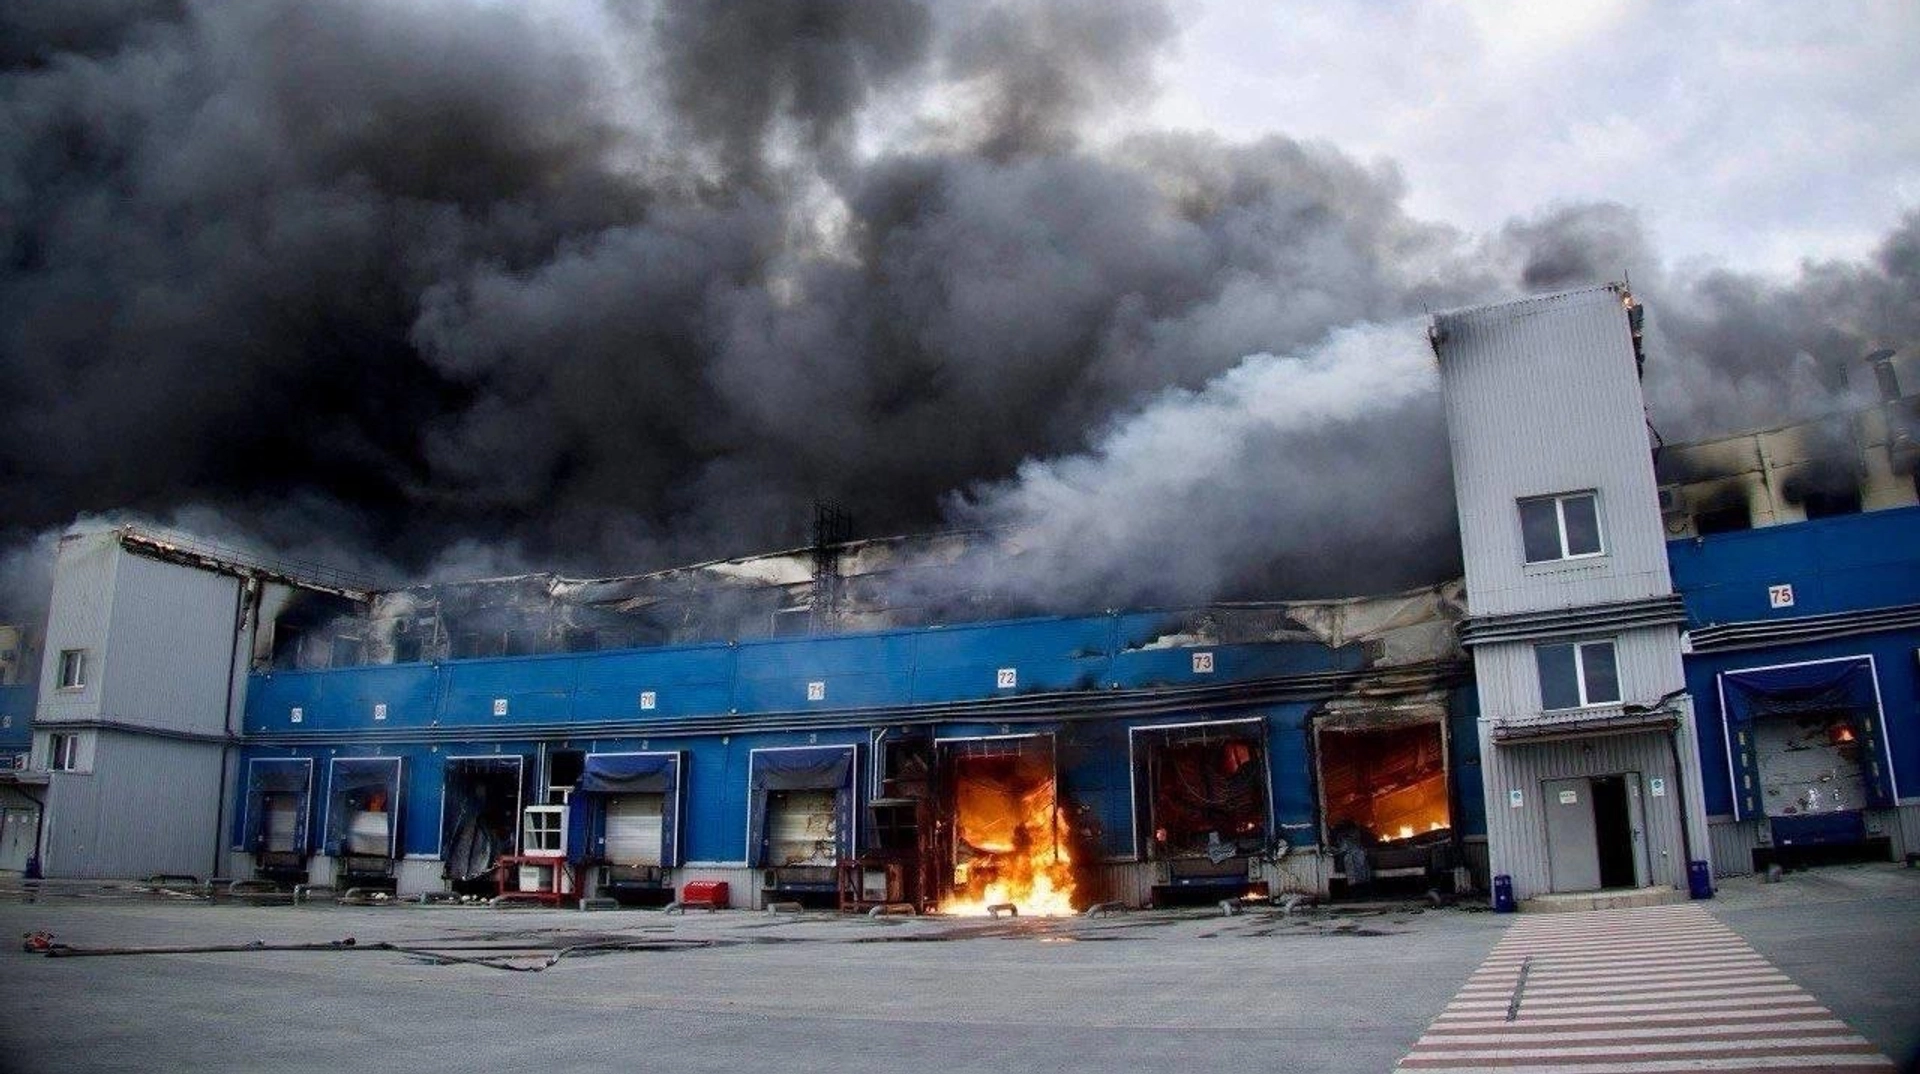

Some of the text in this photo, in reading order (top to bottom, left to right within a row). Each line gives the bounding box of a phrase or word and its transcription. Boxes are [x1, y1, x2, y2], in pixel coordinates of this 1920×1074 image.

[1772, 589, 1791, 603] 75
[1195, 657, 1211, 669] 73
[1000, 672, 1014, 683] 72
[810, 685, 822, 696] 71
[643, 695, 653, 706] 70
